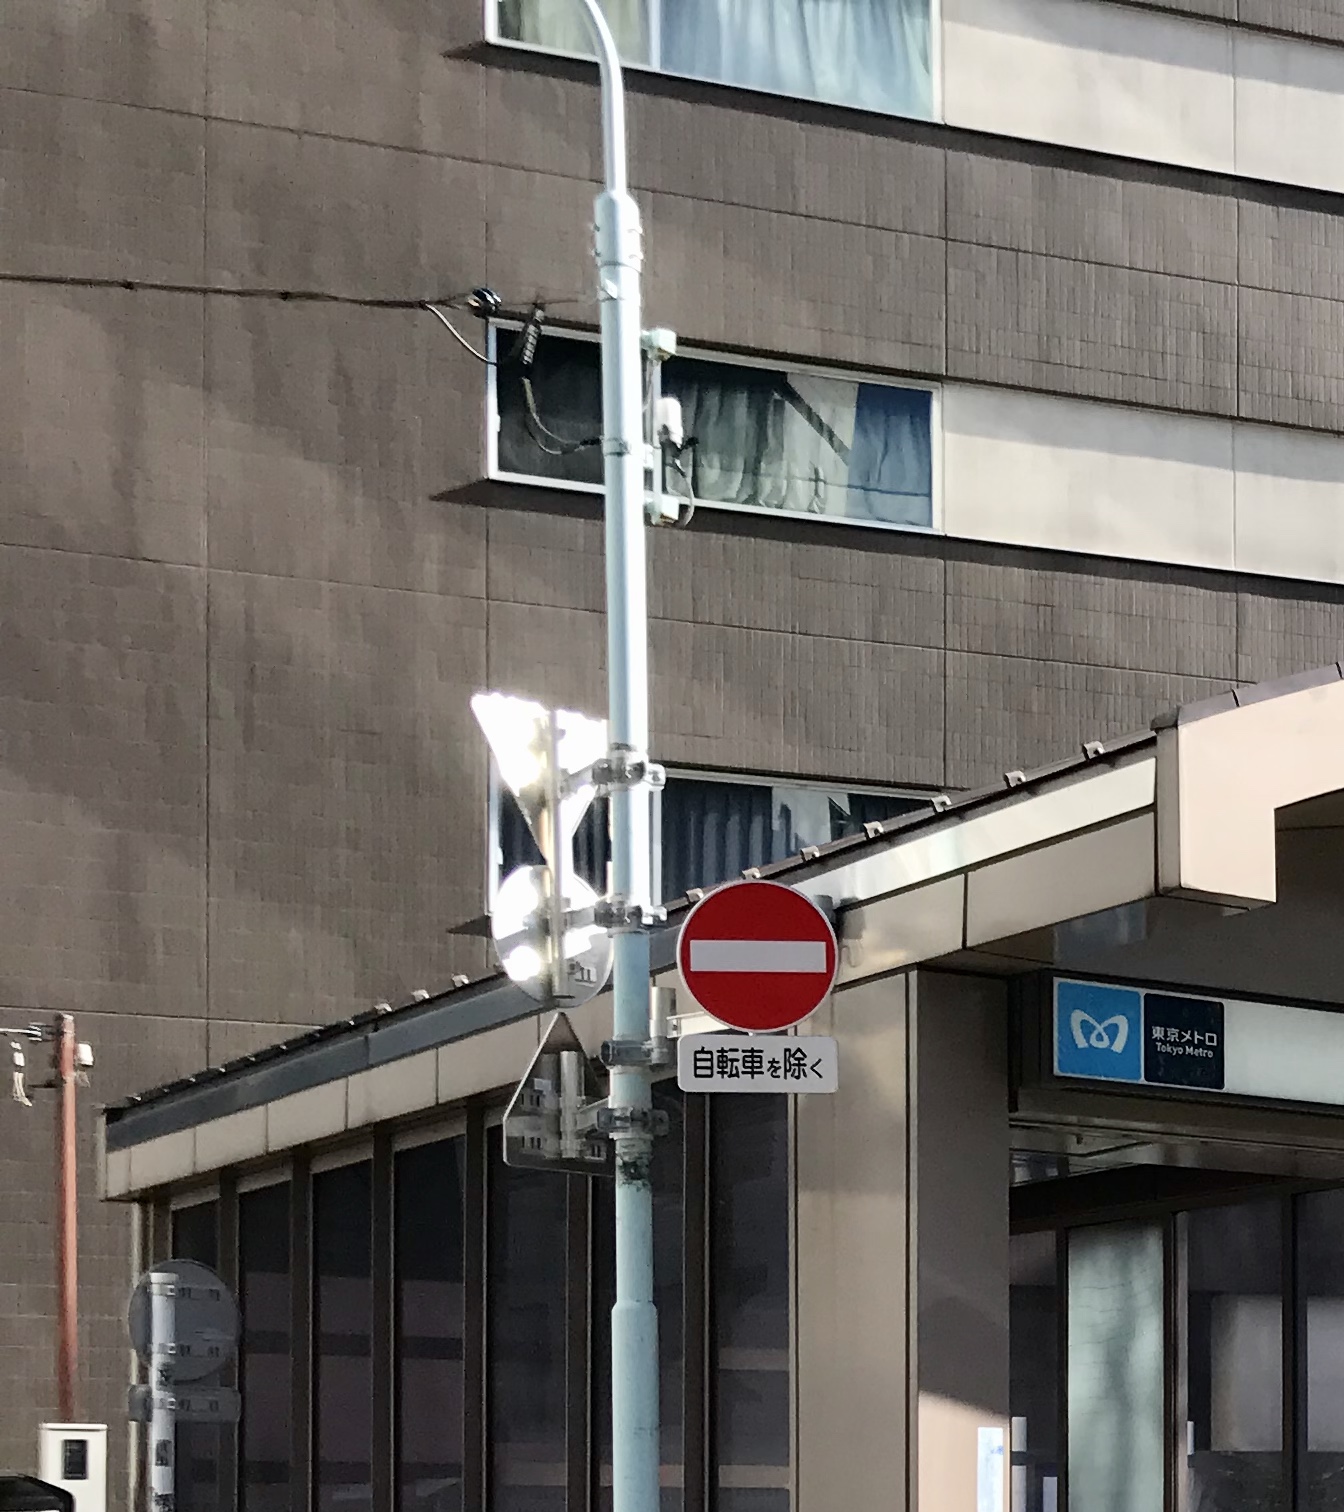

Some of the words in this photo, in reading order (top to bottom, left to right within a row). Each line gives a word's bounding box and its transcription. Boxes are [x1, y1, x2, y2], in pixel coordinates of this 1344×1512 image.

[1151, 1025, 1218, 1047] 東京メトロ
[1155, 1042, 1184, 1057] Tokyo
[1185, 1045, 1214, 1059] Metro
[693, 1046, 824, 1081] 自転車を除く
